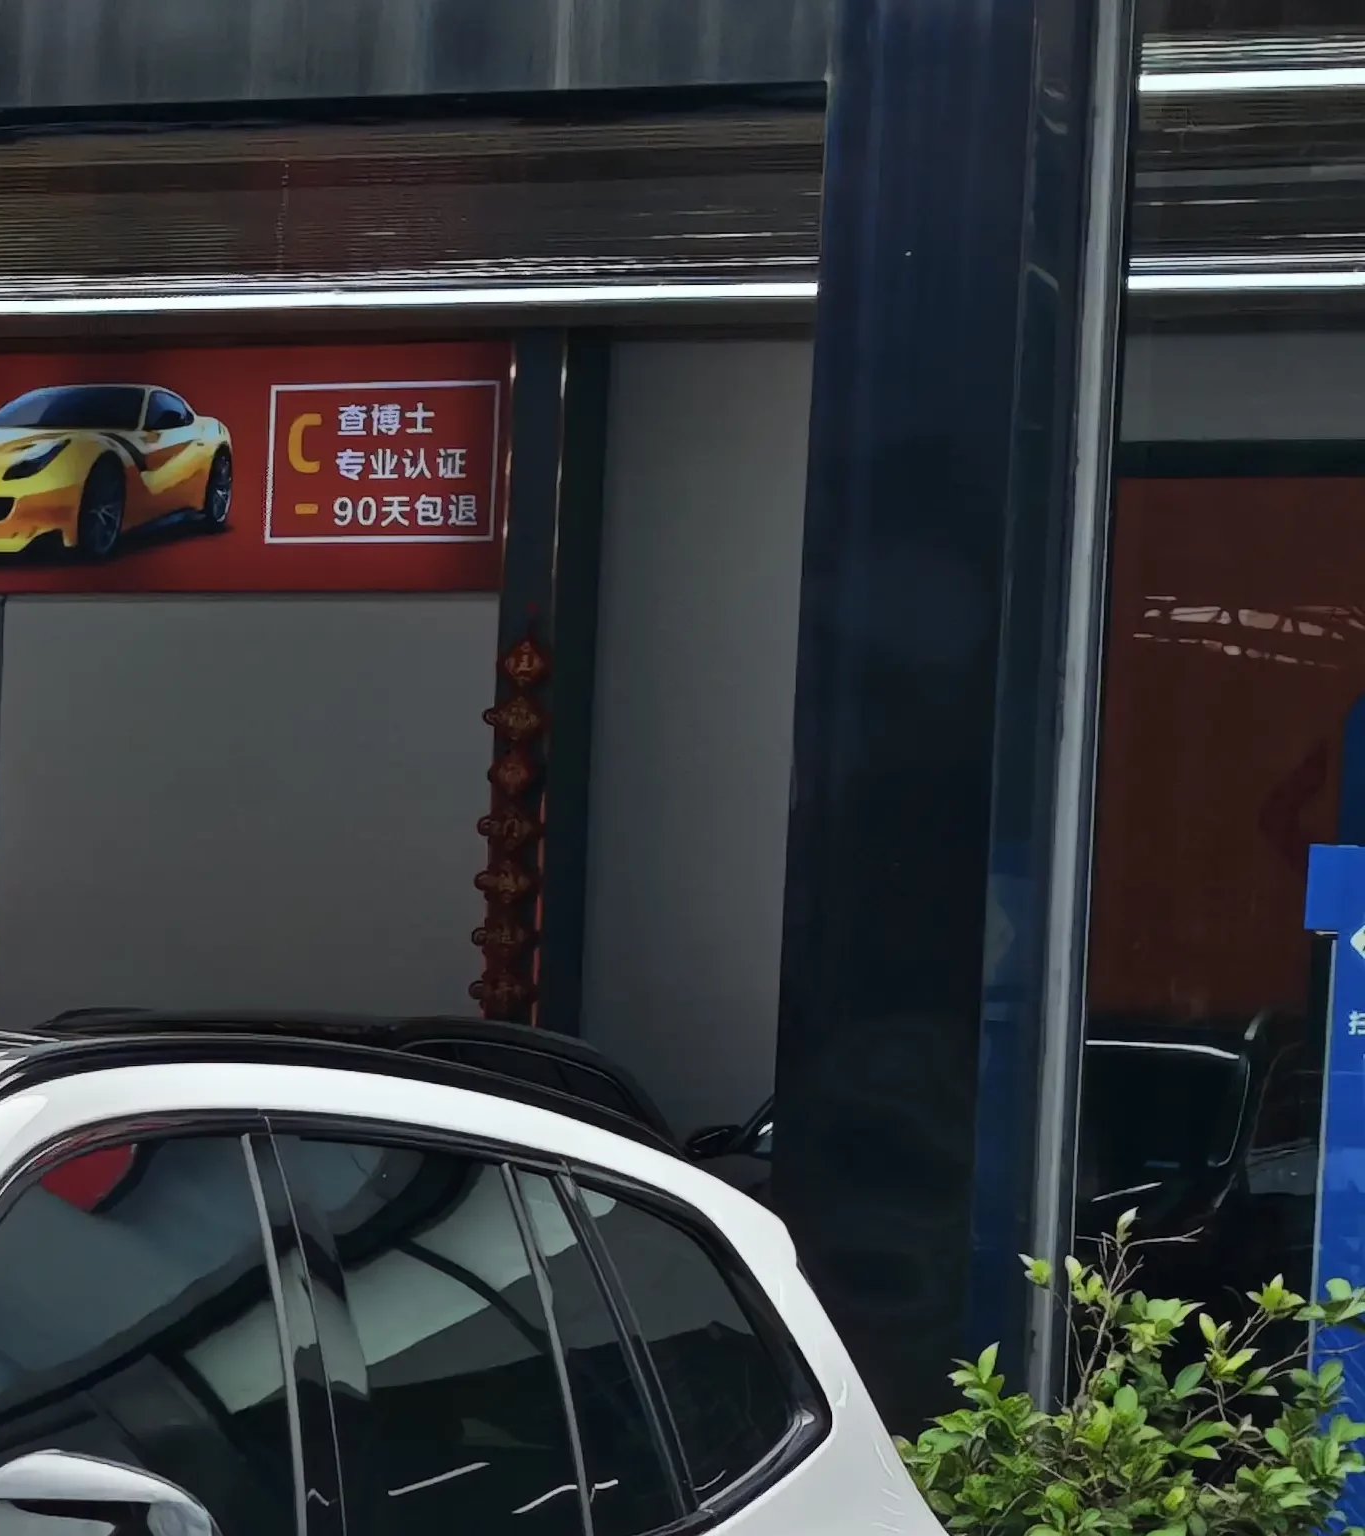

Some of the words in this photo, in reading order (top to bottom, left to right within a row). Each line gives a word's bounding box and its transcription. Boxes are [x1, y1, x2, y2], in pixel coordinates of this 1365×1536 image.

[337, 402, 436, 436] 查博士
[335, 448, 468, 481] 专业认证
[332, 494, 478, 527] 90天包退
